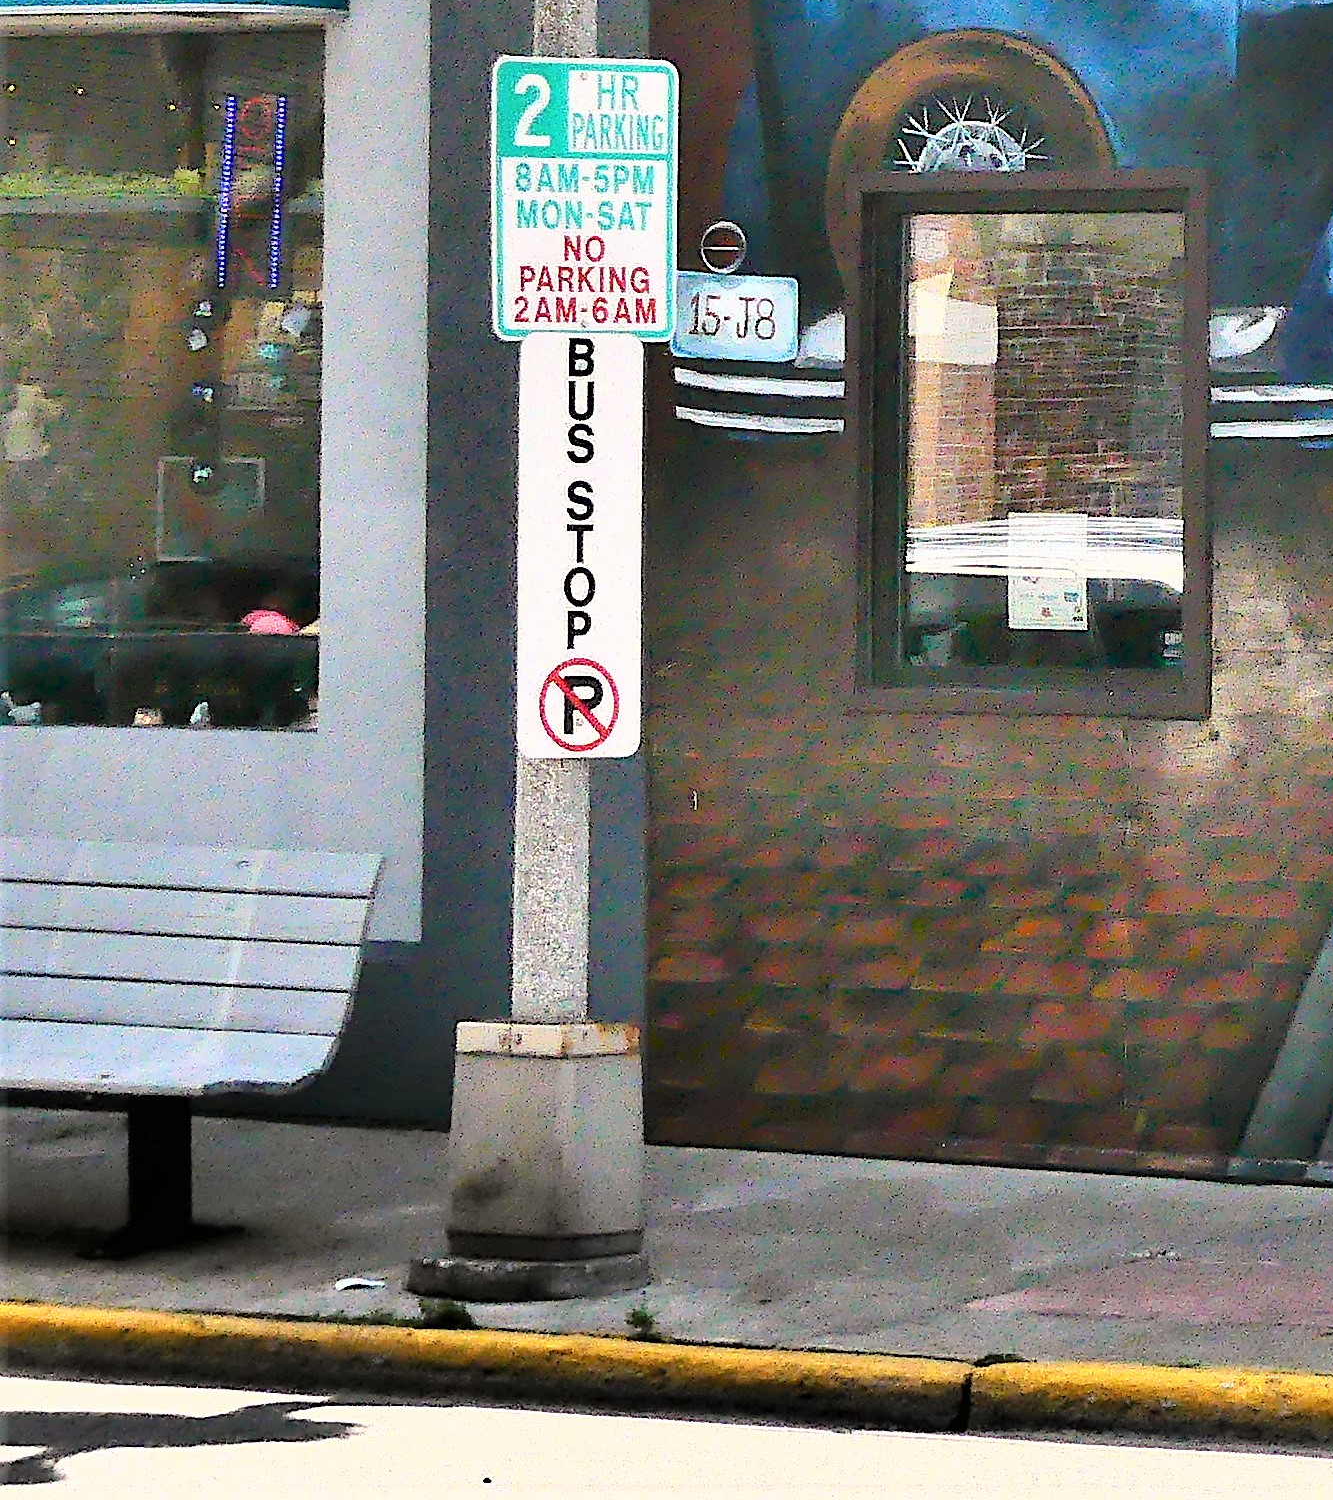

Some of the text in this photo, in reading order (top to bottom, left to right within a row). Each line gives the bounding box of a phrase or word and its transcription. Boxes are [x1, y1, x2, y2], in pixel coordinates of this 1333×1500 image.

[513, 73, 640, 148] 2 HR
[572, 113, 666, 151] PARKING
[515, 163, 655, 195] 8AM-5PM
[516, 199, 653, 231] MON-SAT
[563, 235, 606, 263] NO
[519, 266, 651, 294] PARKING
[514, 297, 657, 324] 2AM-6AM
[688, 292, 776, 340] 15-J8
[563, 338, 597, 650] BUS STOP
